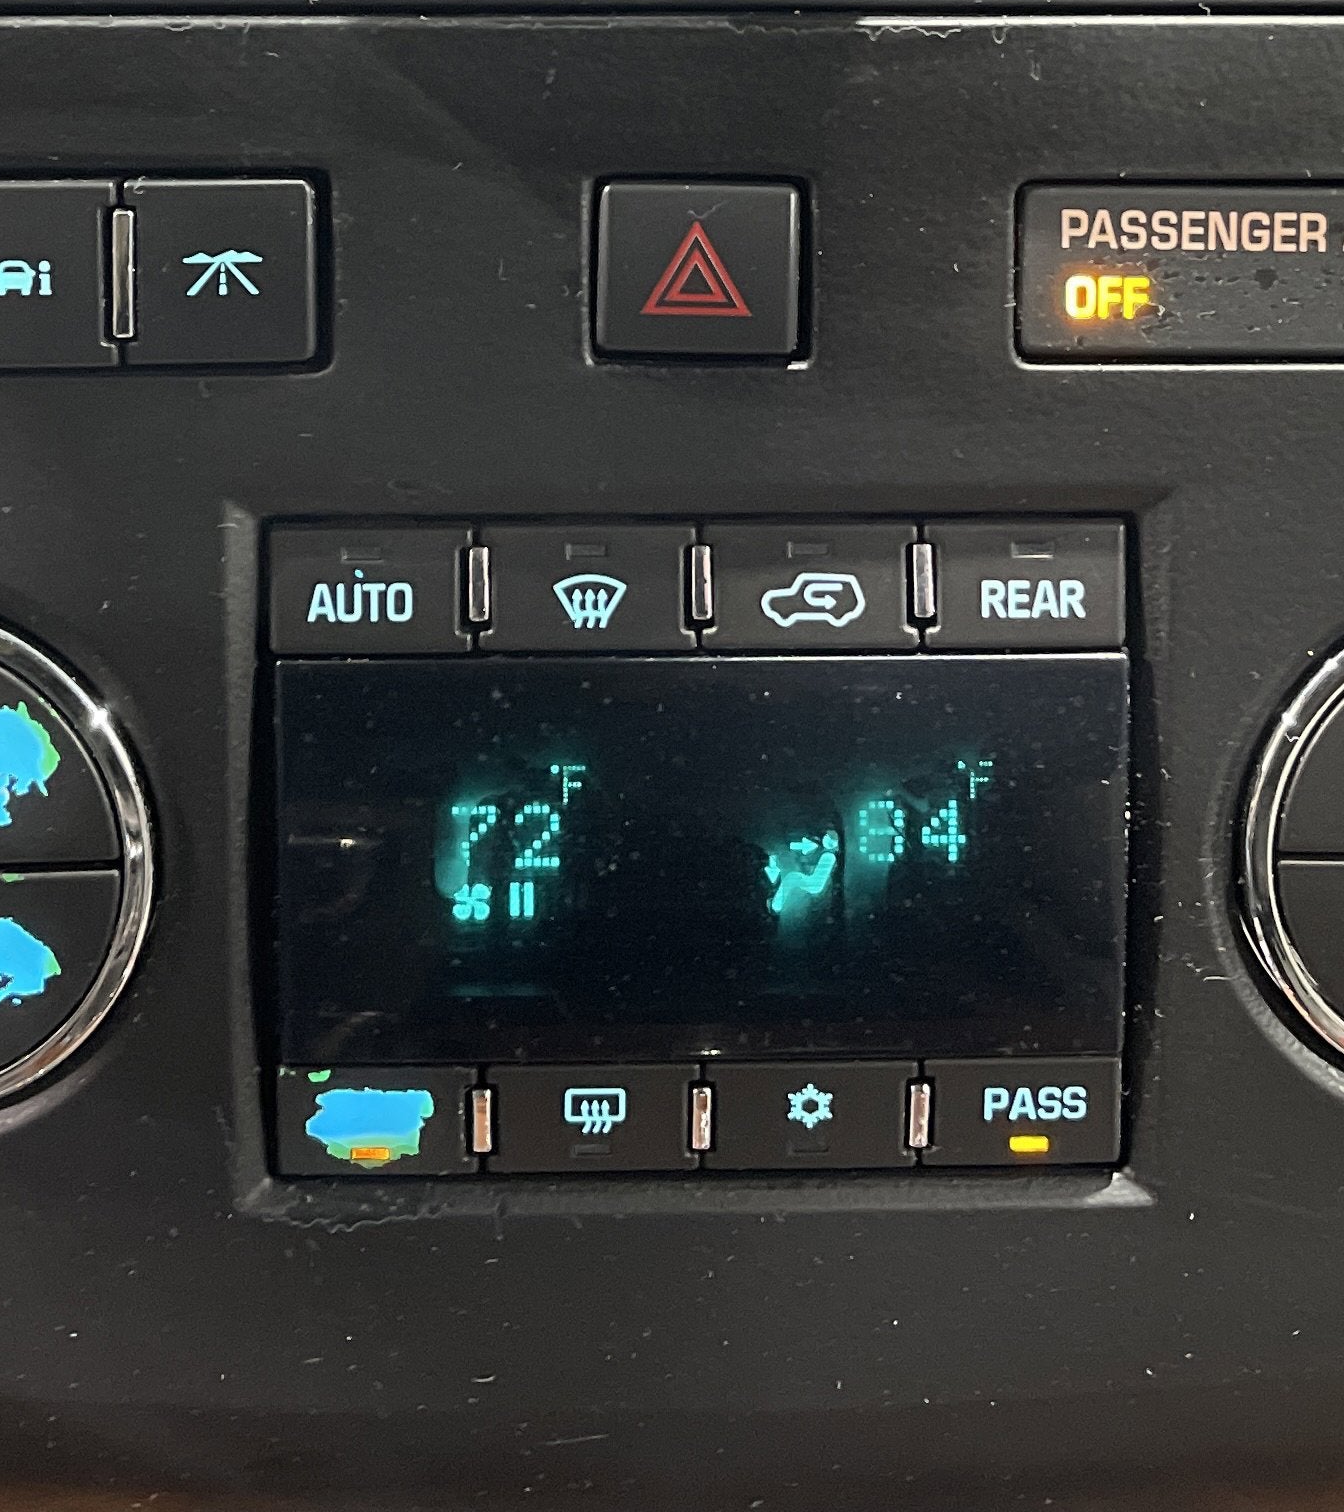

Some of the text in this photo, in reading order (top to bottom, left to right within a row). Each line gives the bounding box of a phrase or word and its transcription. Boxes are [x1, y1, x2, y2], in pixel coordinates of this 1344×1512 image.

[1061, 208, 1327, 253] PASSENGER
[1065, 273, 1151, 321] OFF
[307, 582, 413, 623] AUTO
[980, 579, 1087, 619] REAR
[451, 804, 562, 868] 72
[983, 1086, 1087, 1121] PASS
